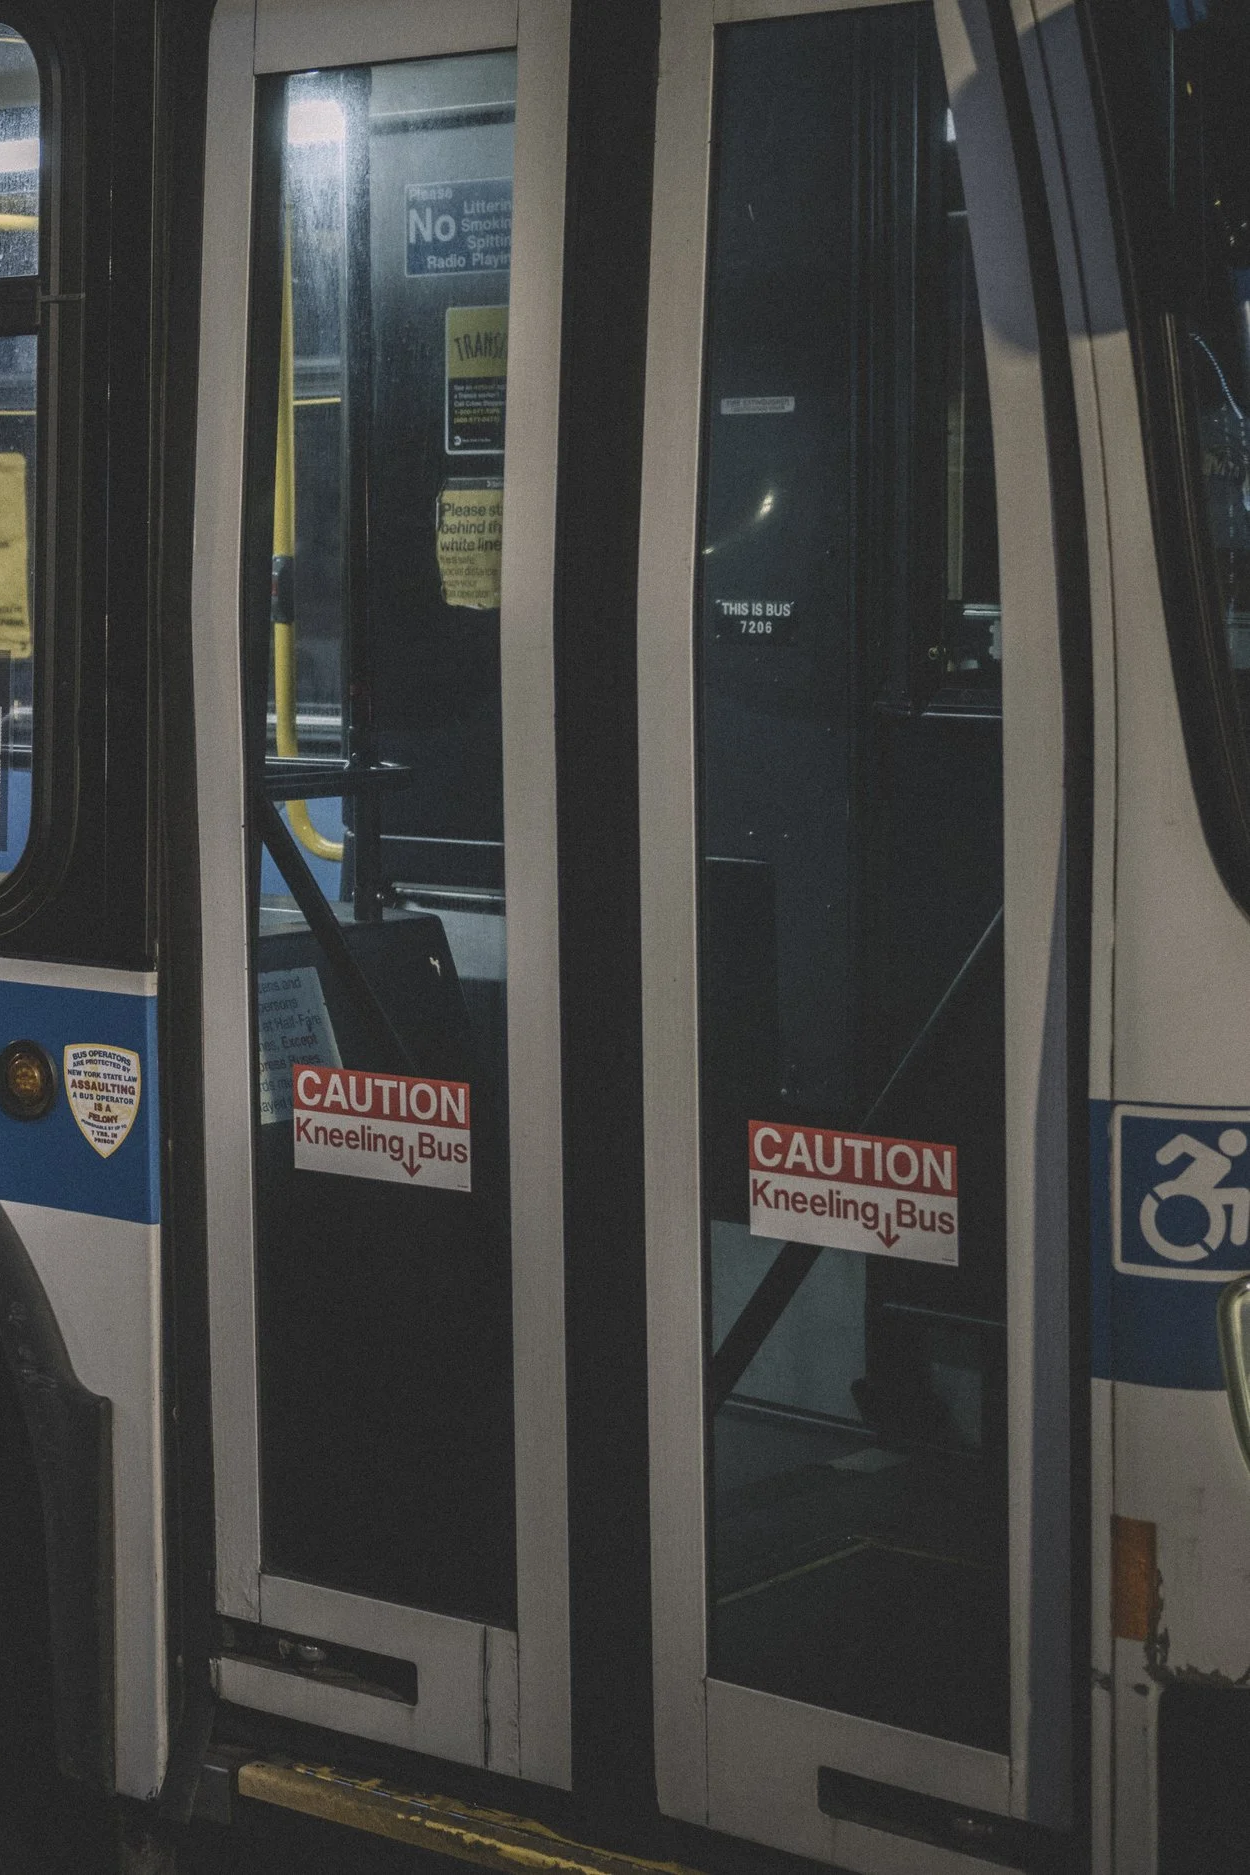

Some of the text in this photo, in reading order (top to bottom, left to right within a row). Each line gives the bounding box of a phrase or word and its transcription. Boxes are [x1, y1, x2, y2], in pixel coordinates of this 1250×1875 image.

[409, 207, 456, 244] No
[426, 253, 466, 269] Radio
[442, 503, 486, 517] Please
[440, 520, 485, 534] behind
[440, 538, 476, 552] white
[721, 602, 791, 617] THIS IS BUS
[740, 620, 772, 634] 7206
[281, 1034, 319, 1050] Except
[72, 1050, 131, 1066] BUS OPERATORS
[72, 1059, 131, 1073] ARE PROTECTED BY
[103, 1073, 123, 1081] STATE
[70, 1079, 136, 1095] ASSAULTING
[96, 1094, 134, 1105] OPERATOR
[297, 1069, 466, 1124] CAUTION
[94, 1103, 111, 1113] IS A
[88, 1112, 118, 1124] FELONY
[94, 1137, 115, 1145] PRISON
[296, 1117, 468, 1164] Kneeling Bus
[753, 1127, 952, 1191] CAUTION
[752, 1178, 955, 1235] Kneeling Bus
